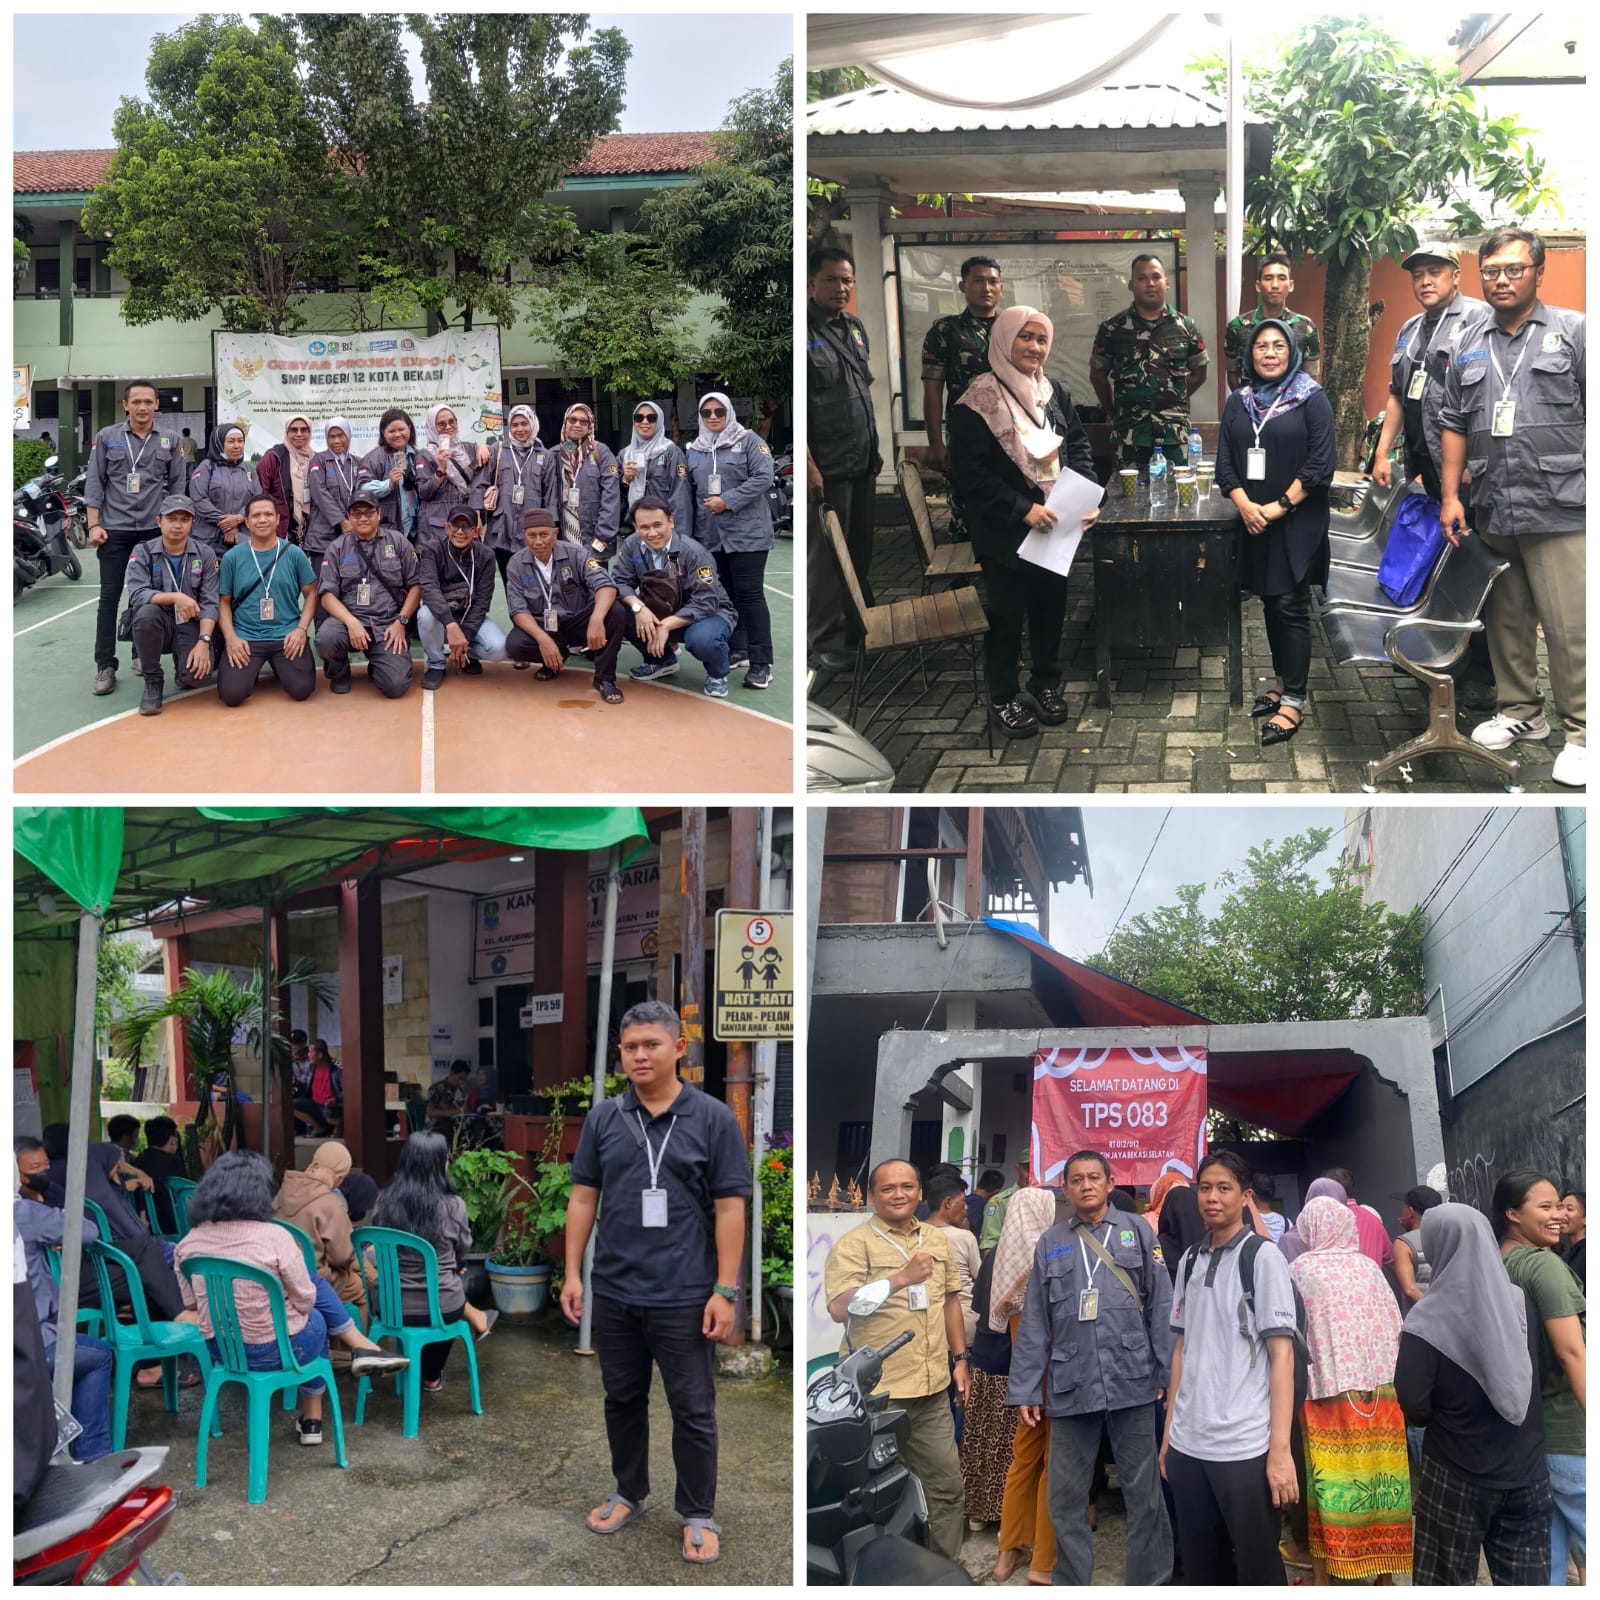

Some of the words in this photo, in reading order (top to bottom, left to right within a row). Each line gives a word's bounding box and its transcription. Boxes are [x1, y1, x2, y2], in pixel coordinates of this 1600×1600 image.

[266, 359, 332, 371] GEBYAR
[336, 357, 396, 369] PROJEK
[281, 374, 306, 385] SMP
[310, 373, 350, 385] NEGERI
[353, 372, 365, 383] 12
[369, 371, 400, 383] KOTA
[403, 369, 443, 382] BEKASI
[755, 921, 765, 936] 5
[725, 992, 793, 1005] HATI-HATI
[535, 1000, 549, 1011] TPS
[726, 1011, 752, 1022] PELAN
[760, 1010, 790, 1022] PELAN
[721, 1024, 747, 1032] BANYAK
[748, 1024, 767, 1032] ANAK
[1070, 1079, 1120, 1093] SELAMAT
[1121, 1078, 1166, 1091] DATANG
[1168, 1078, 1179, 1089] DI
[1081, 1102, 1122, 1129] TPS
[1127, 1101, 1168, 1128] 083
[1108, 1141, 1116, 1149] RT
[1116, 1140, 1140, 1148] 012/012
[1111, 1151, 1127, 1160] JAYA
[1127, 1150, 1147, 1159] BEKASI
[1148, 1150, 1175, 1159] SELATAN
